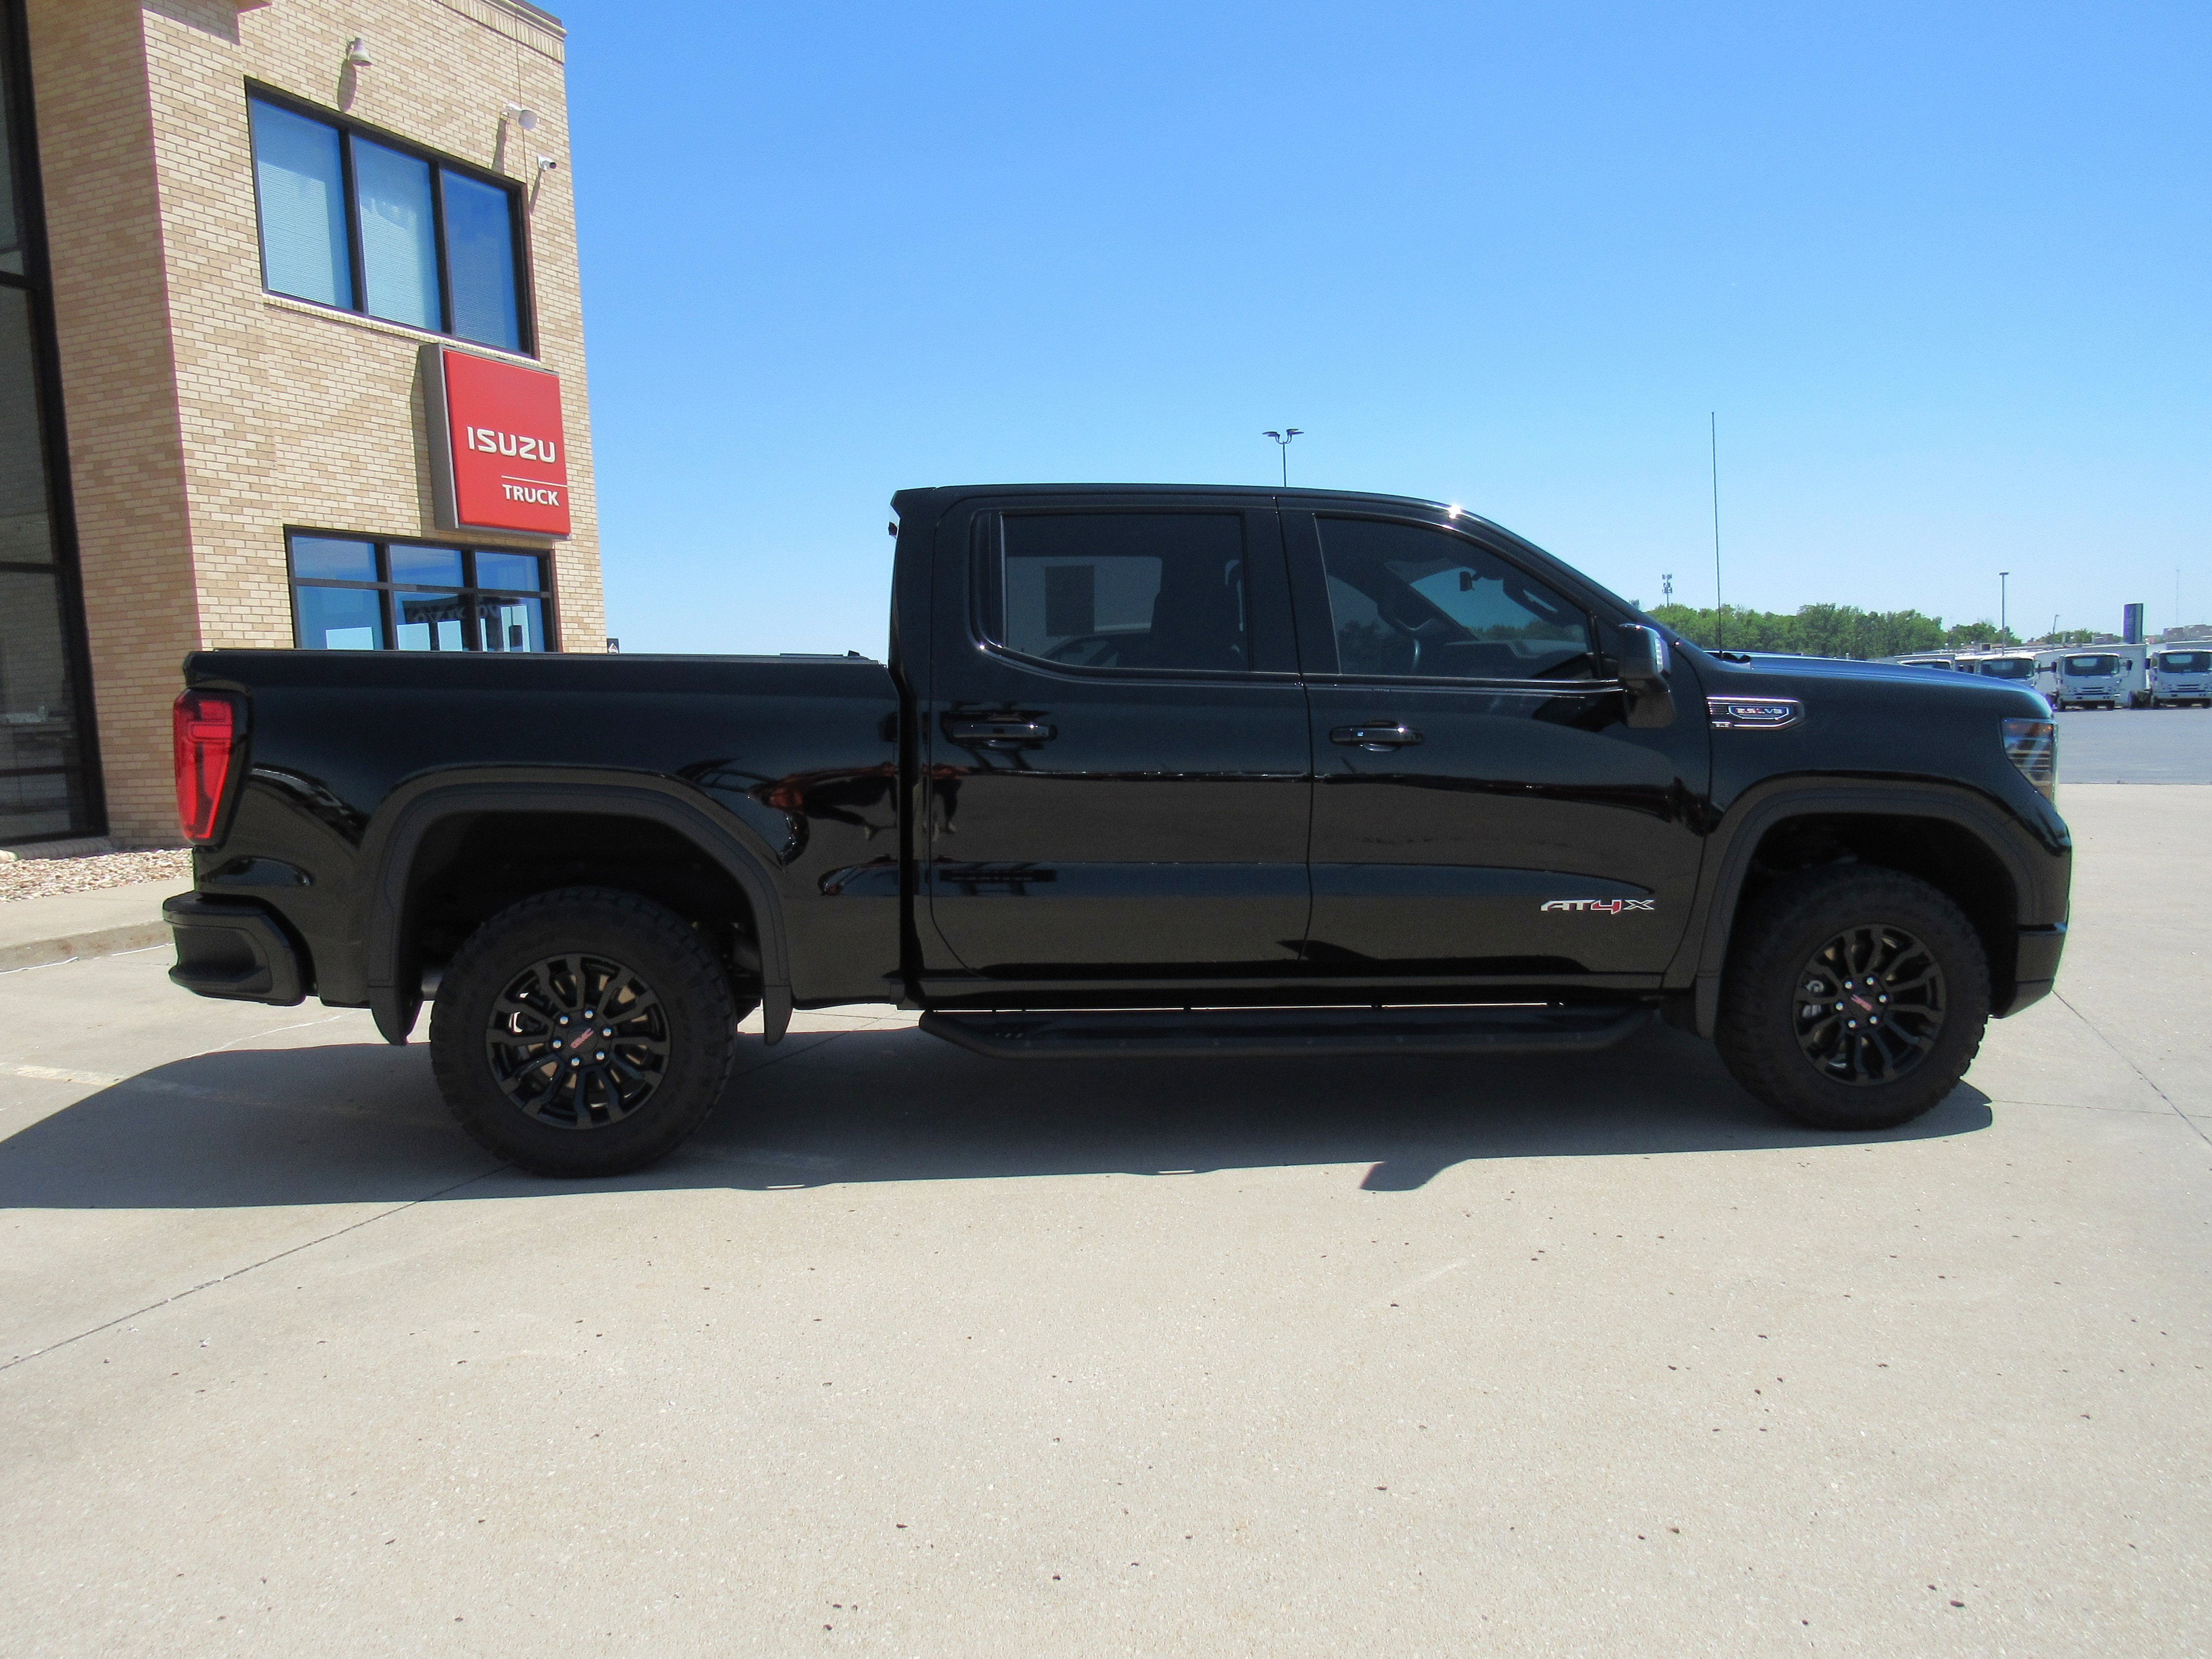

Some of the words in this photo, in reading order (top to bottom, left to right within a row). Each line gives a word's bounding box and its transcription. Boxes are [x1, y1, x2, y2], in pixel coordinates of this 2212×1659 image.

[466, 426, 556, 463] ISUZU
[501, 484, 560, 506] TRUCK
[1540, 899, 1655, 915] AT4X
